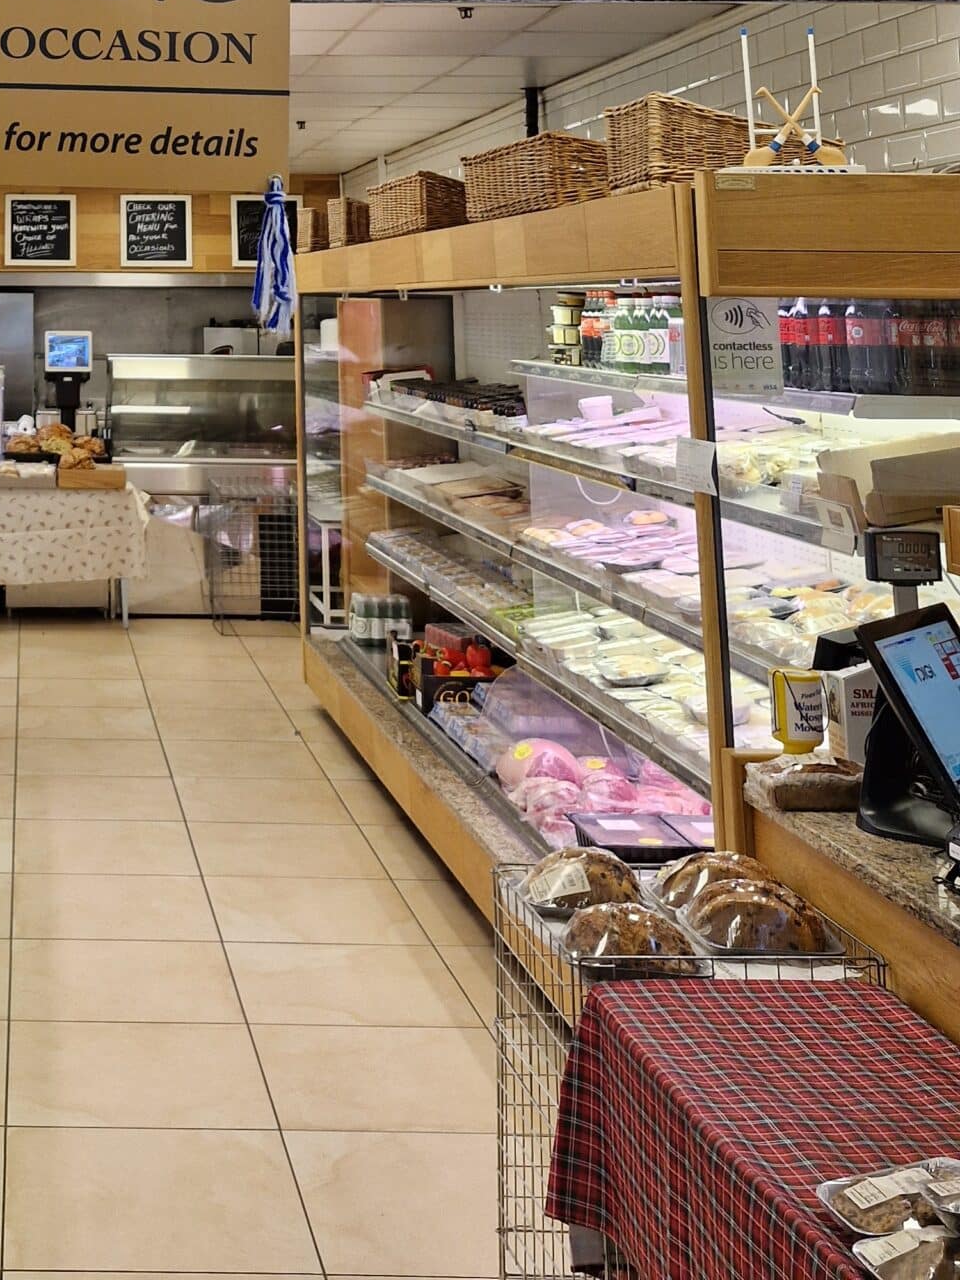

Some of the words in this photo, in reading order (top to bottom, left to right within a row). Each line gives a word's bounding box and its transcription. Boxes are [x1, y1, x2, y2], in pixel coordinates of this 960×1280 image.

[0, 26, 258, 65] OCCASION
[0, 121, 52, 157] for
[57, 131, 141, 155] more
[149, 124, 259, 158] details
[712, 341, 774, 352] contactless
[730, 351, 775, 370] here
[852, 688, 874, 699] SM
[850, 701, 875, 709] AFRIC
